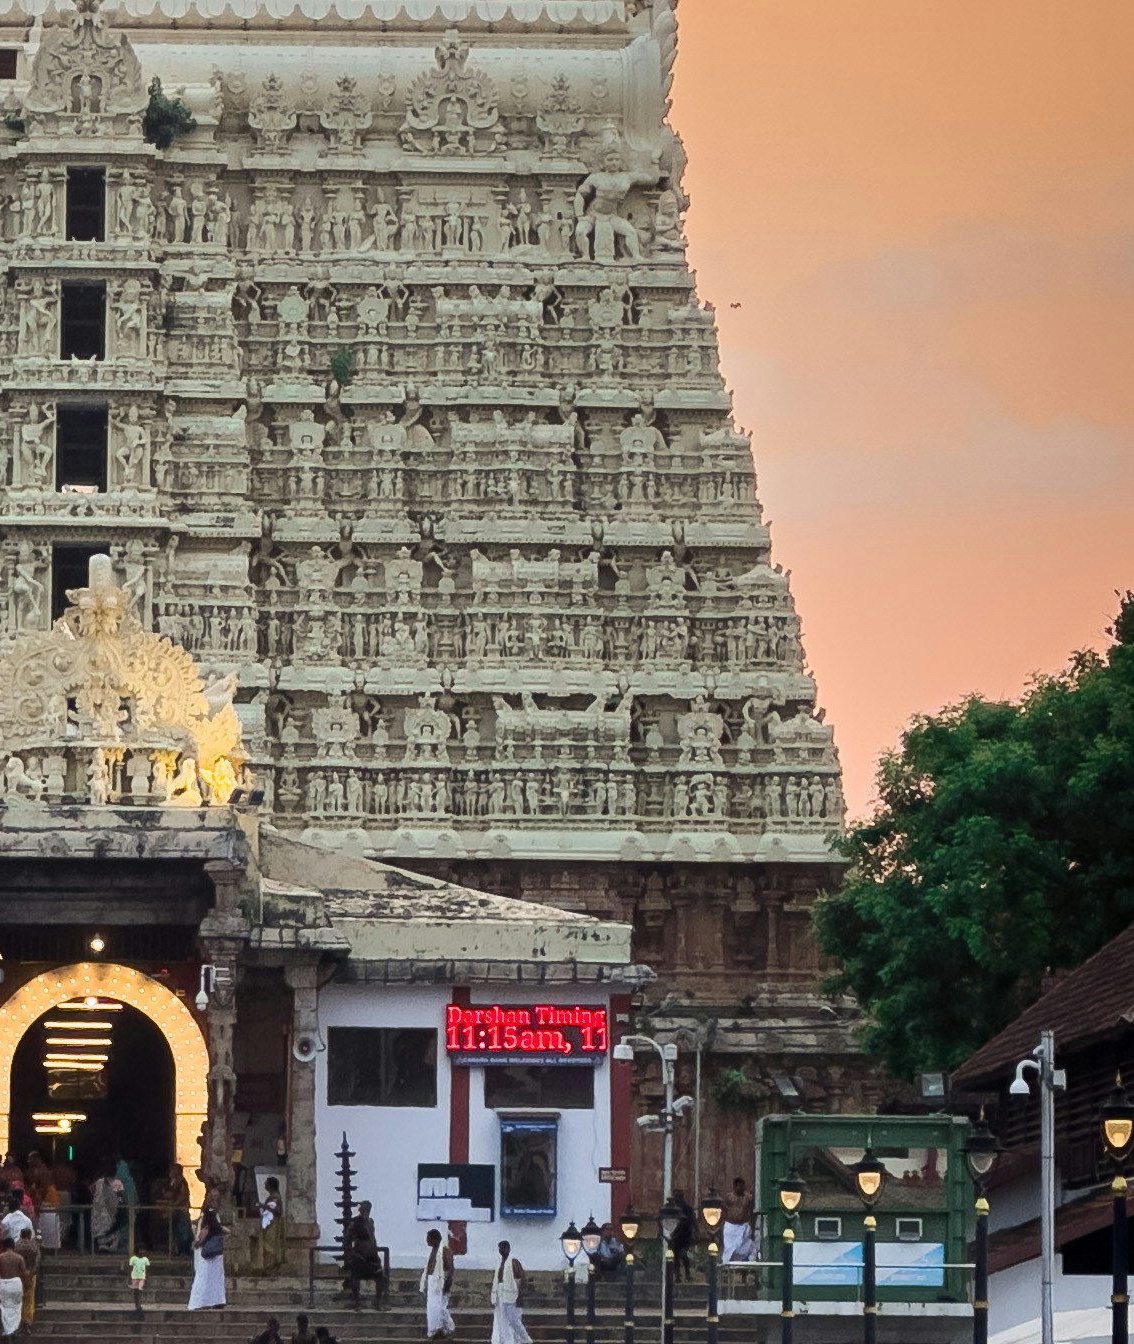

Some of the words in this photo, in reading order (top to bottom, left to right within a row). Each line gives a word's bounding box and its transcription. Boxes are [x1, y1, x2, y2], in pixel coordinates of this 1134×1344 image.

[447, 1006, 531, 1024] Darshan
[534, 1006, 606, 1026] Timing
[446, 1025, 571, 1053] 11:15am,
